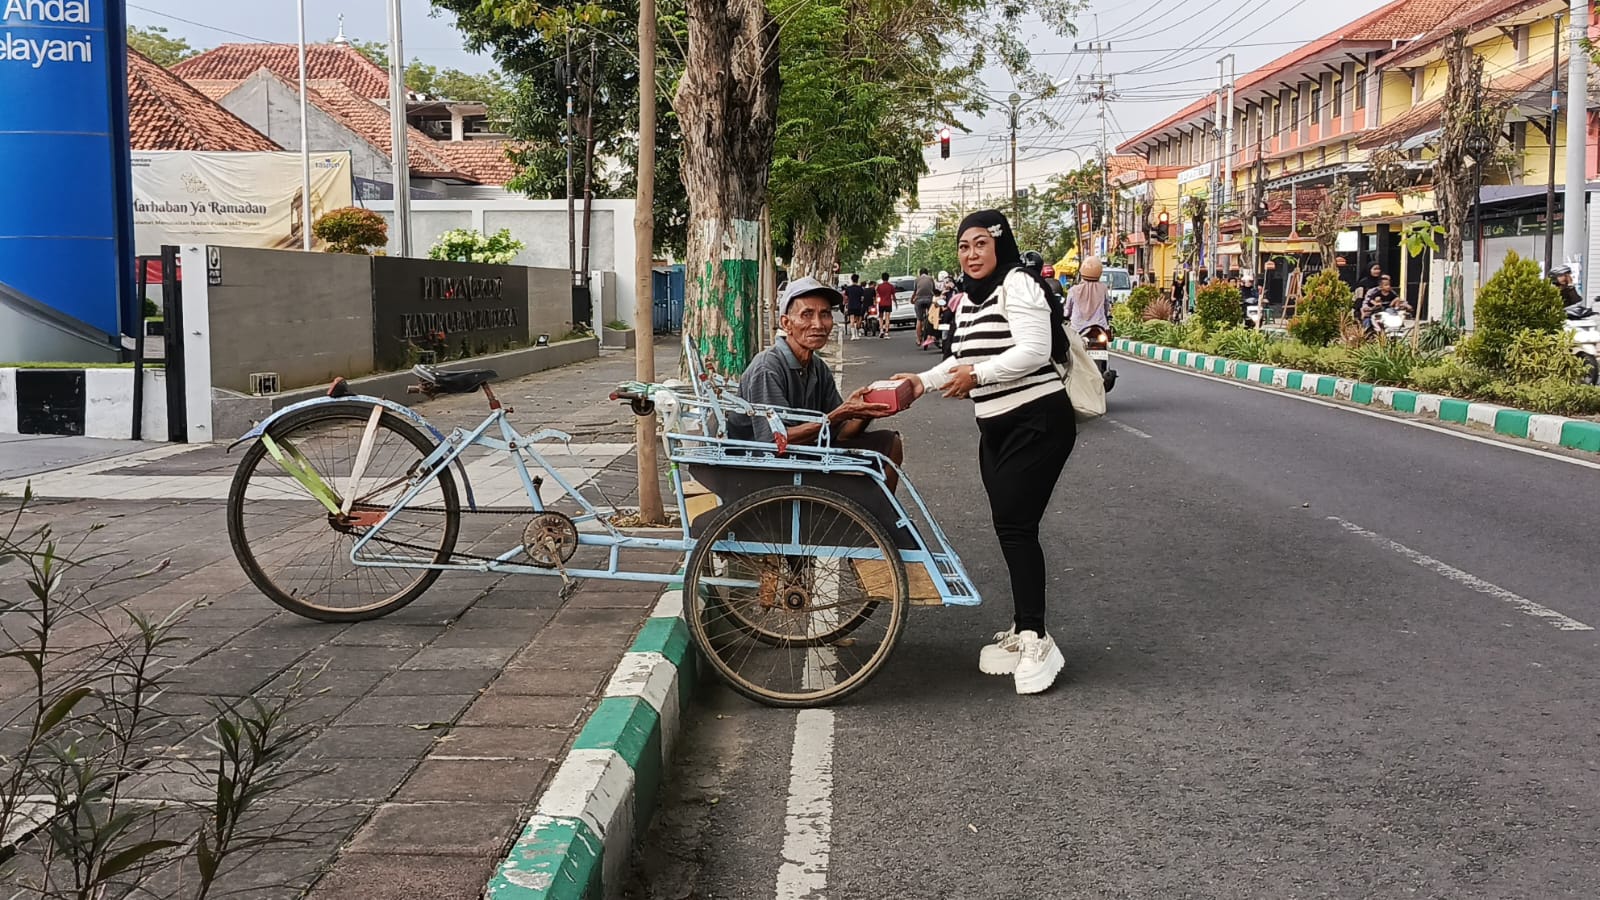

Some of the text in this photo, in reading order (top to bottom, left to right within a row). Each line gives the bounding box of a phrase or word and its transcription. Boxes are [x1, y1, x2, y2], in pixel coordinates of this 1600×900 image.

[2, 0, 90, 23] Andal
[189, 201, 206, 216] Ya
[208, 201, 267, 215] Ramadan
